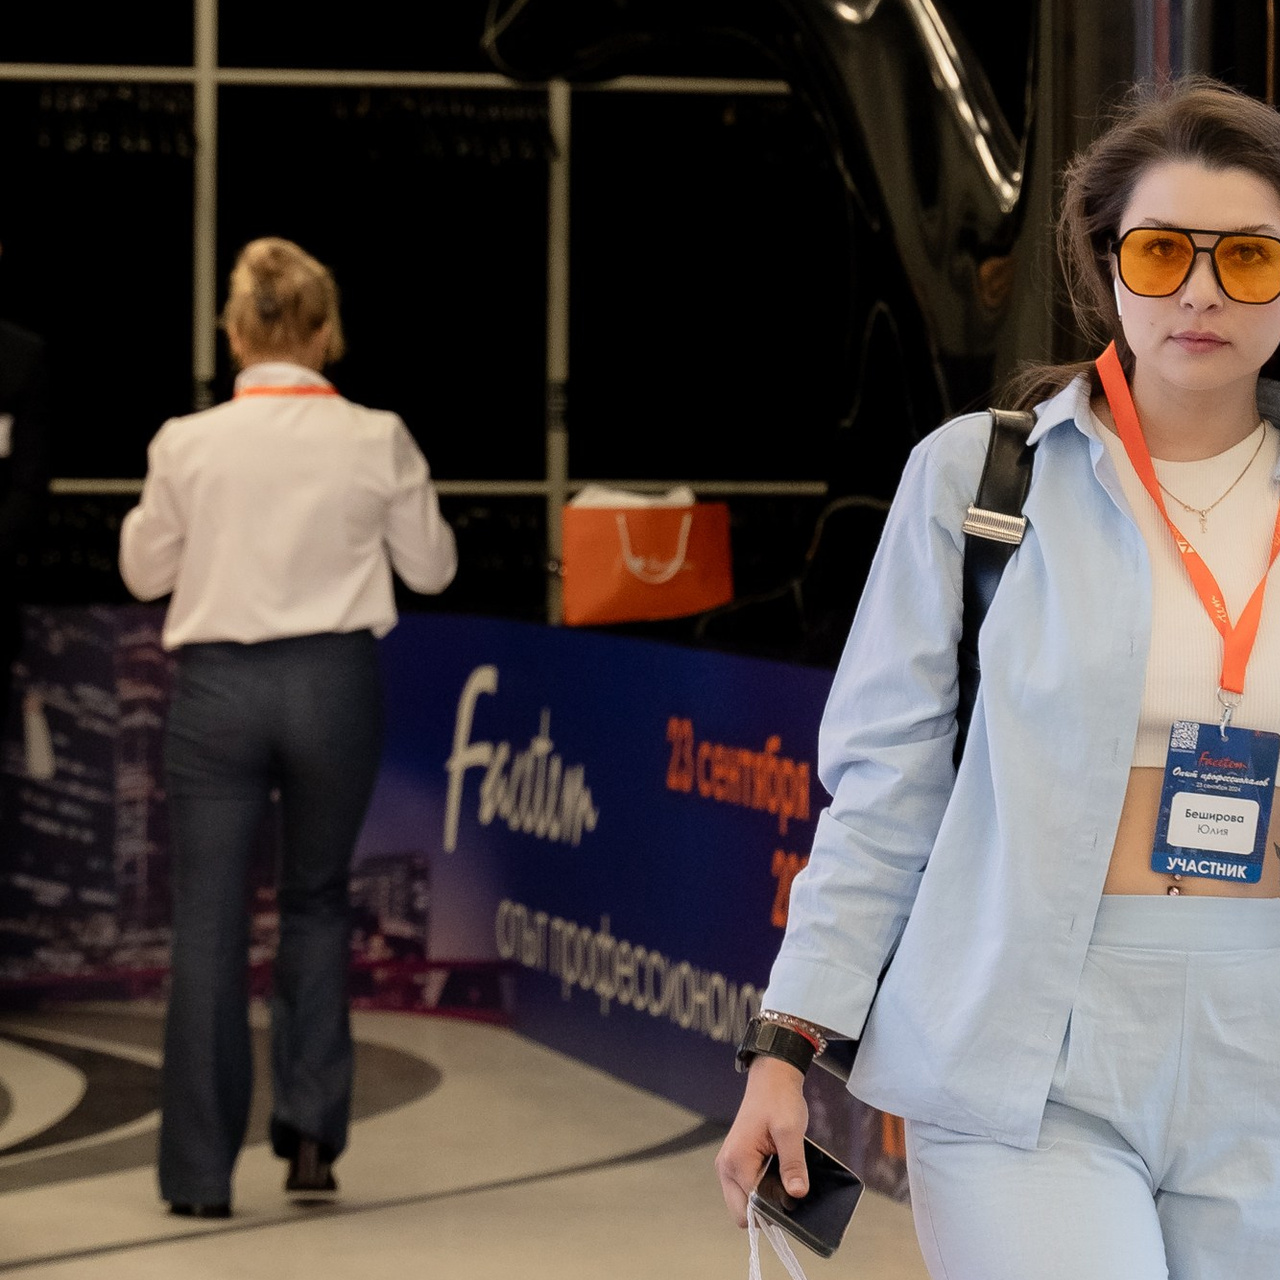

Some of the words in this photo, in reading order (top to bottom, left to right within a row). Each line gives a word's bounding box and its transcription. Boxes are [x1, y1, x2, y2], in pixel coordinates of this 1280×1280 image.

[1185, 808, 1244, 823] Беширова
[1197, 824, 1229, 836] Юлия
[1167, 856, 1248, 879] УЧАСТНИК
